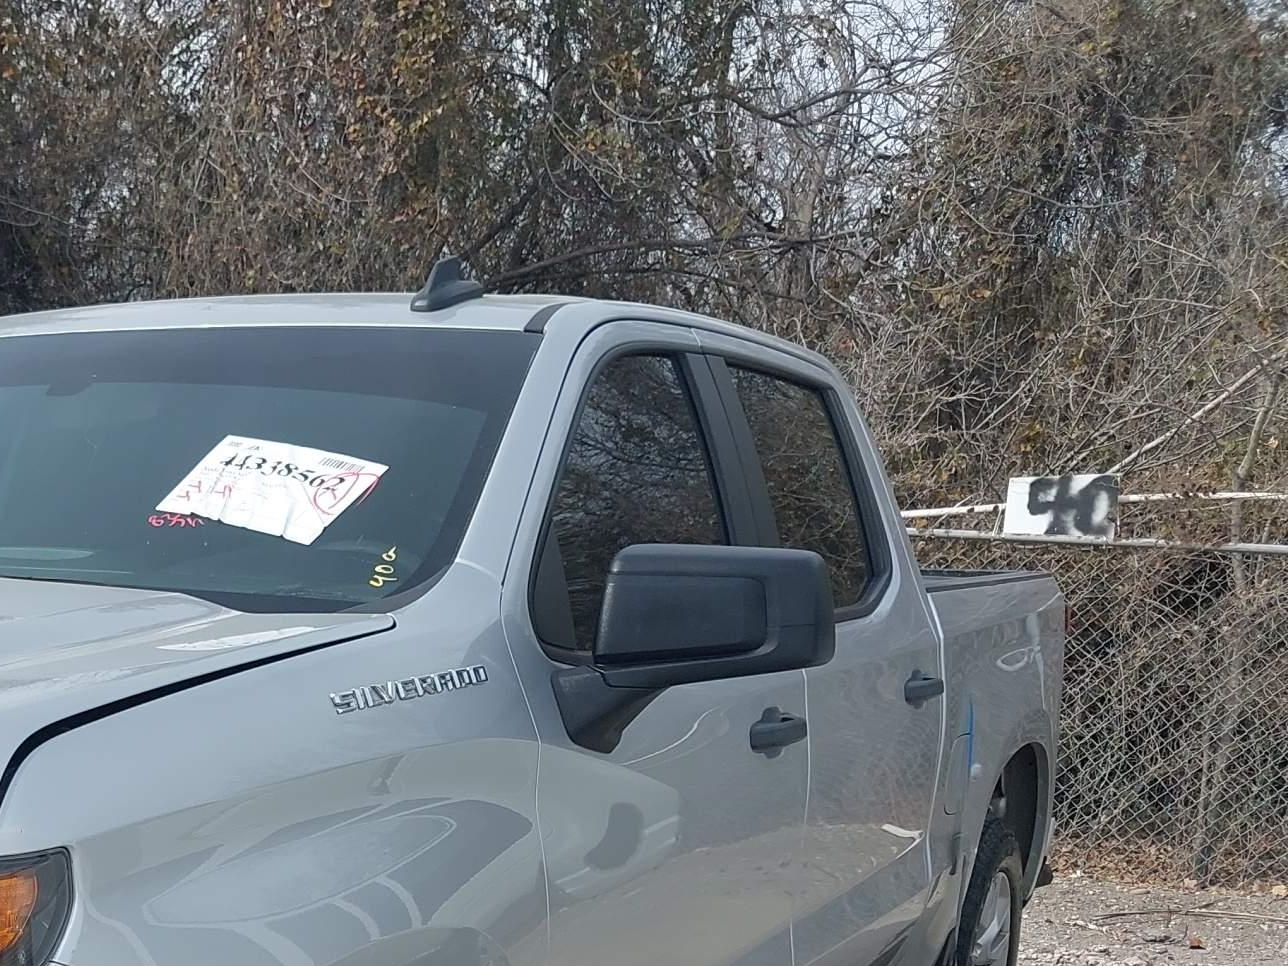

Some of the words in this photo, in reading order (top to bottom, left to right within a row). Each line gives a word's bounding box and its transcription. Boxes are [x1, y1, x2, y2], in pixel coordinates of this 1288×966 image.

[220, 452, 346, 492] 44338562
[1027, 474, 1119, 536] 40
[329, 664, 489, 715] SILVERADO
